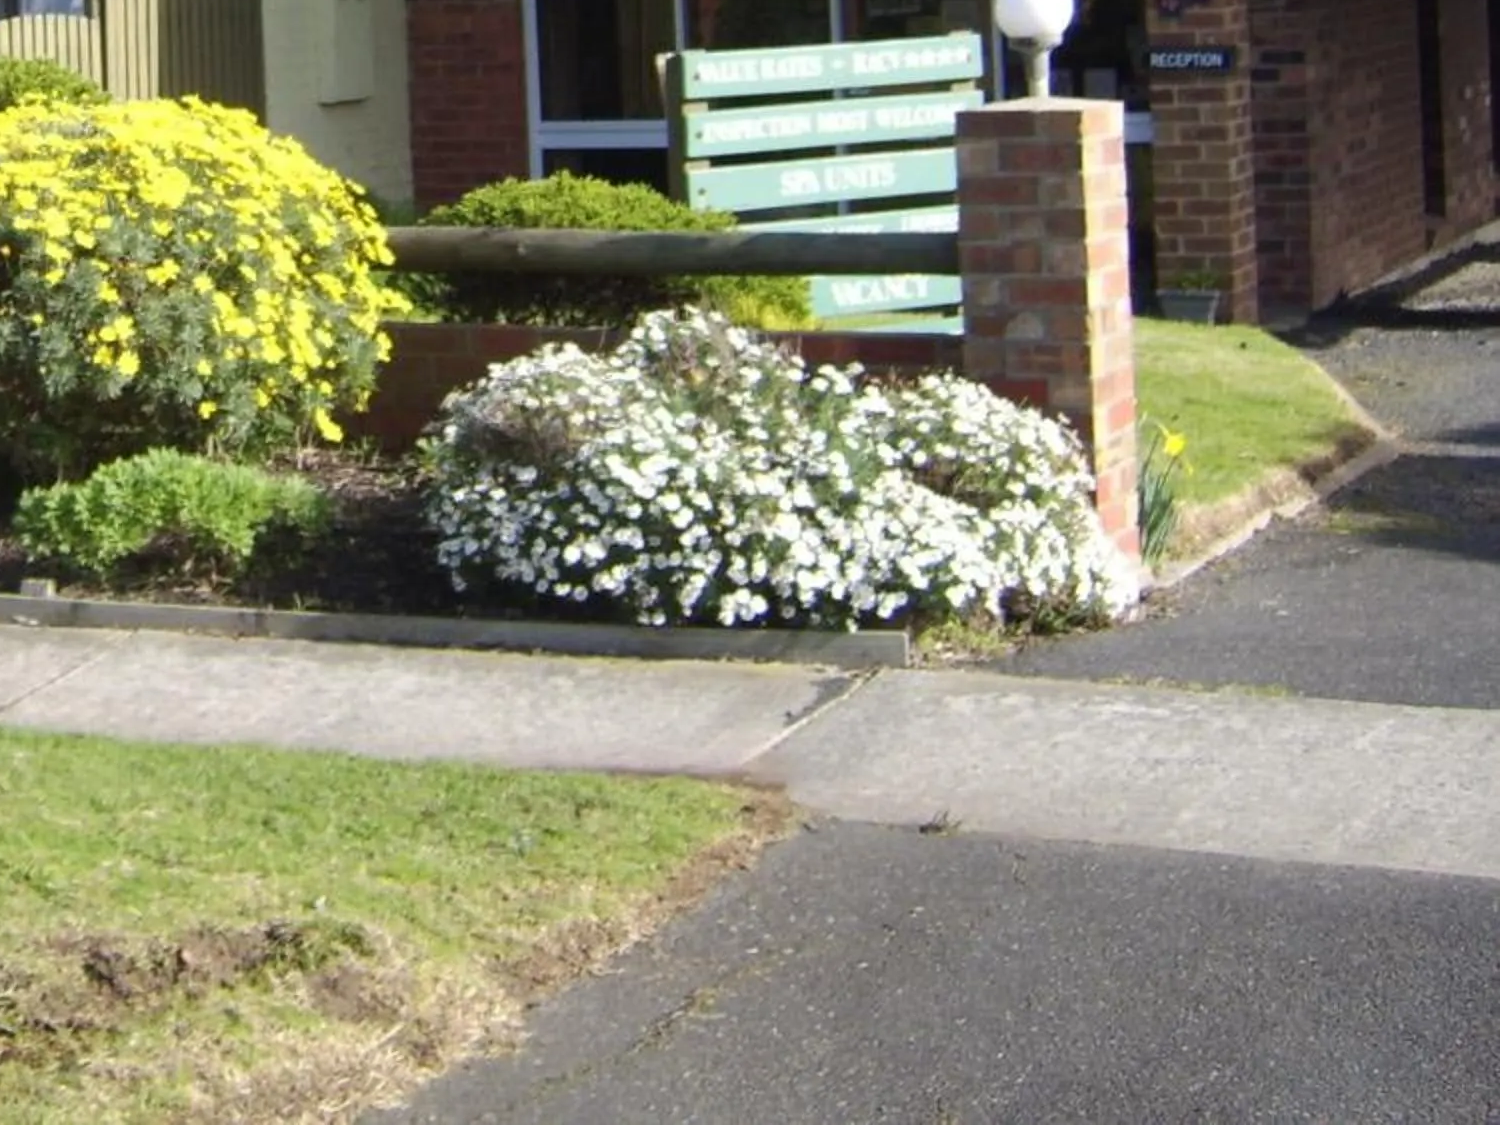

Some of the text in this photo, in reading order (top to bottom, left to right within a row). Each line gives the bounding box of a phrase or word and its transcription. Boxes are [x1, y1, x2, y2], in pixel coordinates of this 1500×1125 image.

[1150, 51, 1224, 69] RECEPTION
[780, 160, 896, 197] SPA UNITS
[830, 274, 930, 306] VACANCY
